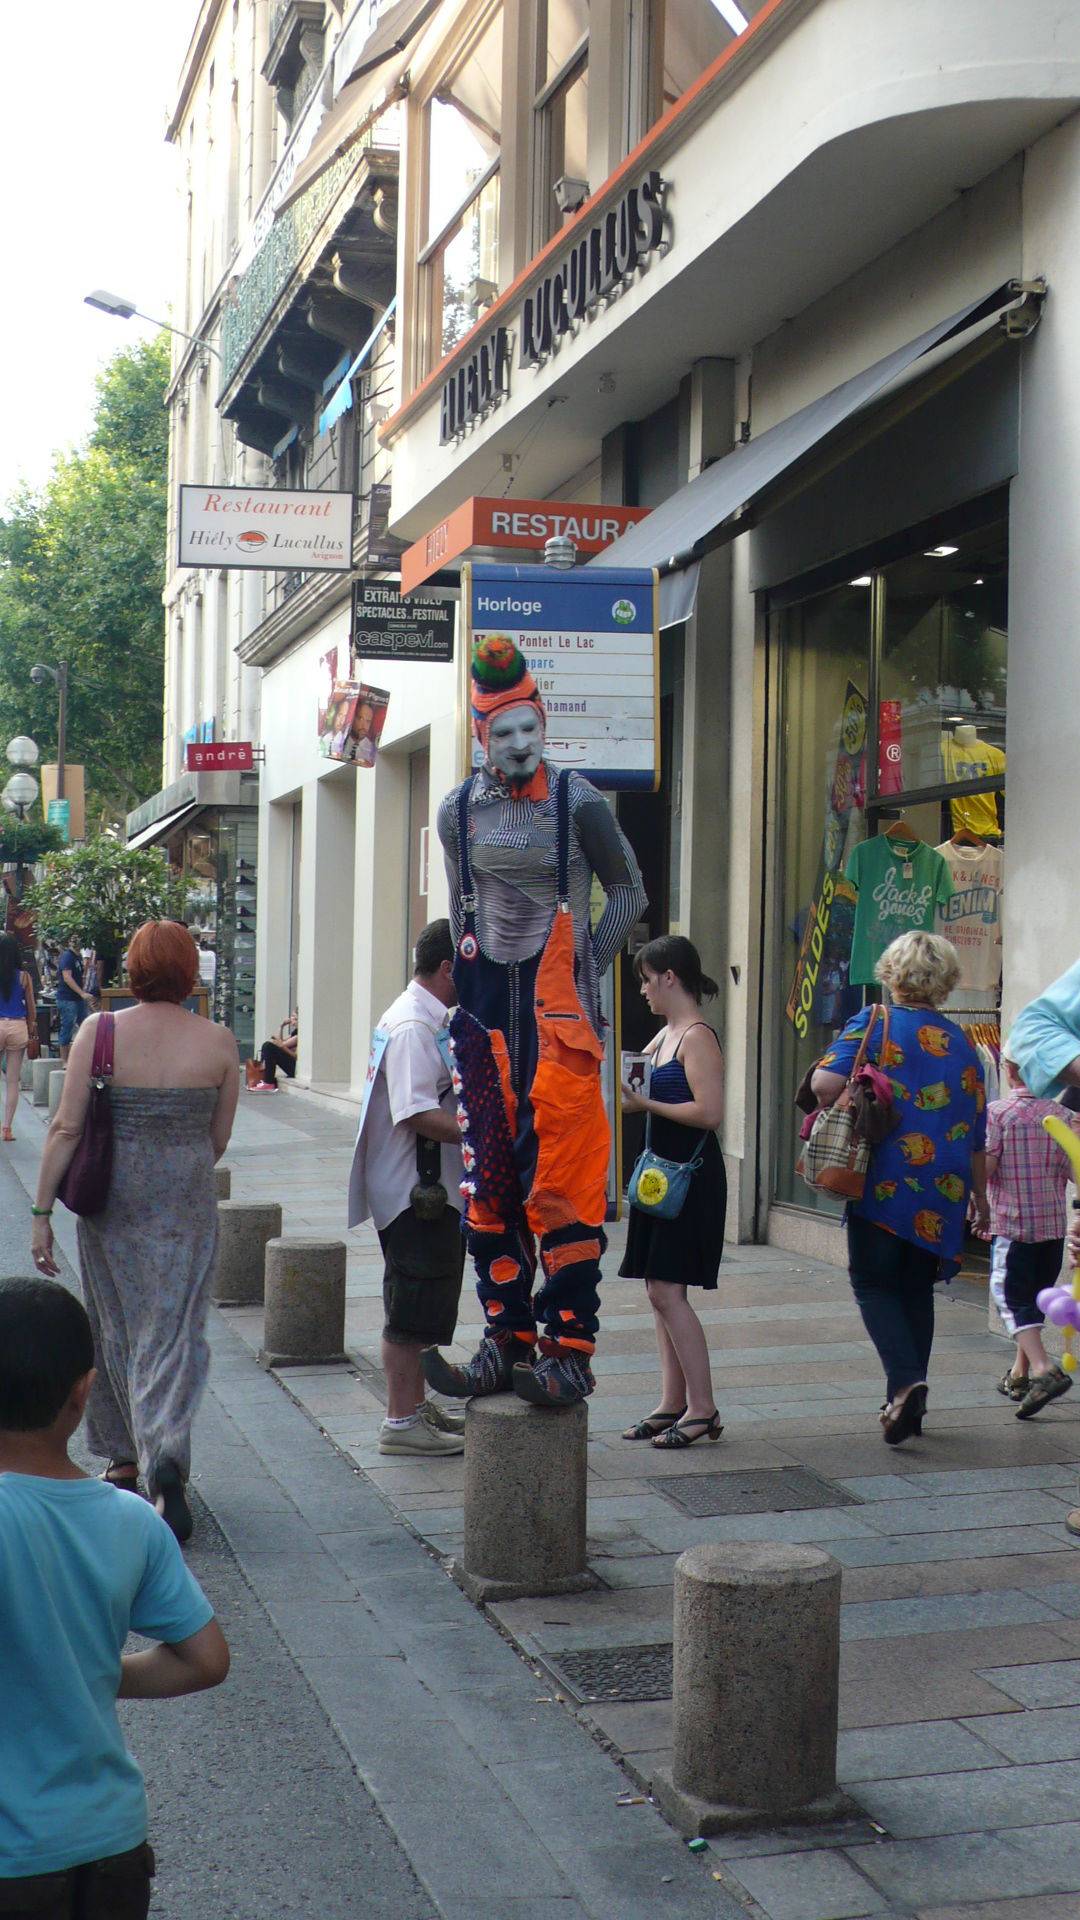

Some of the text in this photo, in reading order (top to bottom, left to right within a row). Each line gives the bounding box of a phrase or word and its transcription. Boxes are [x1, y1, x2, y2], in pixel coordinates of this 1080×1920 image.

[519, 171, 663, 370] LUCULLUS
[203, 493, 332, 517] Restaurant
[189, 531, 344, 550] Hiély Lucullus
[356, 606, 407, 619] SPECTACLES
[412, 608, 450, 621] FESTIVAL
[477, 597, 542, 616] Horloge
[519, 634, 595, 649] Pontet Le Lac
[795, 872, 834, 1039] SOLDES
